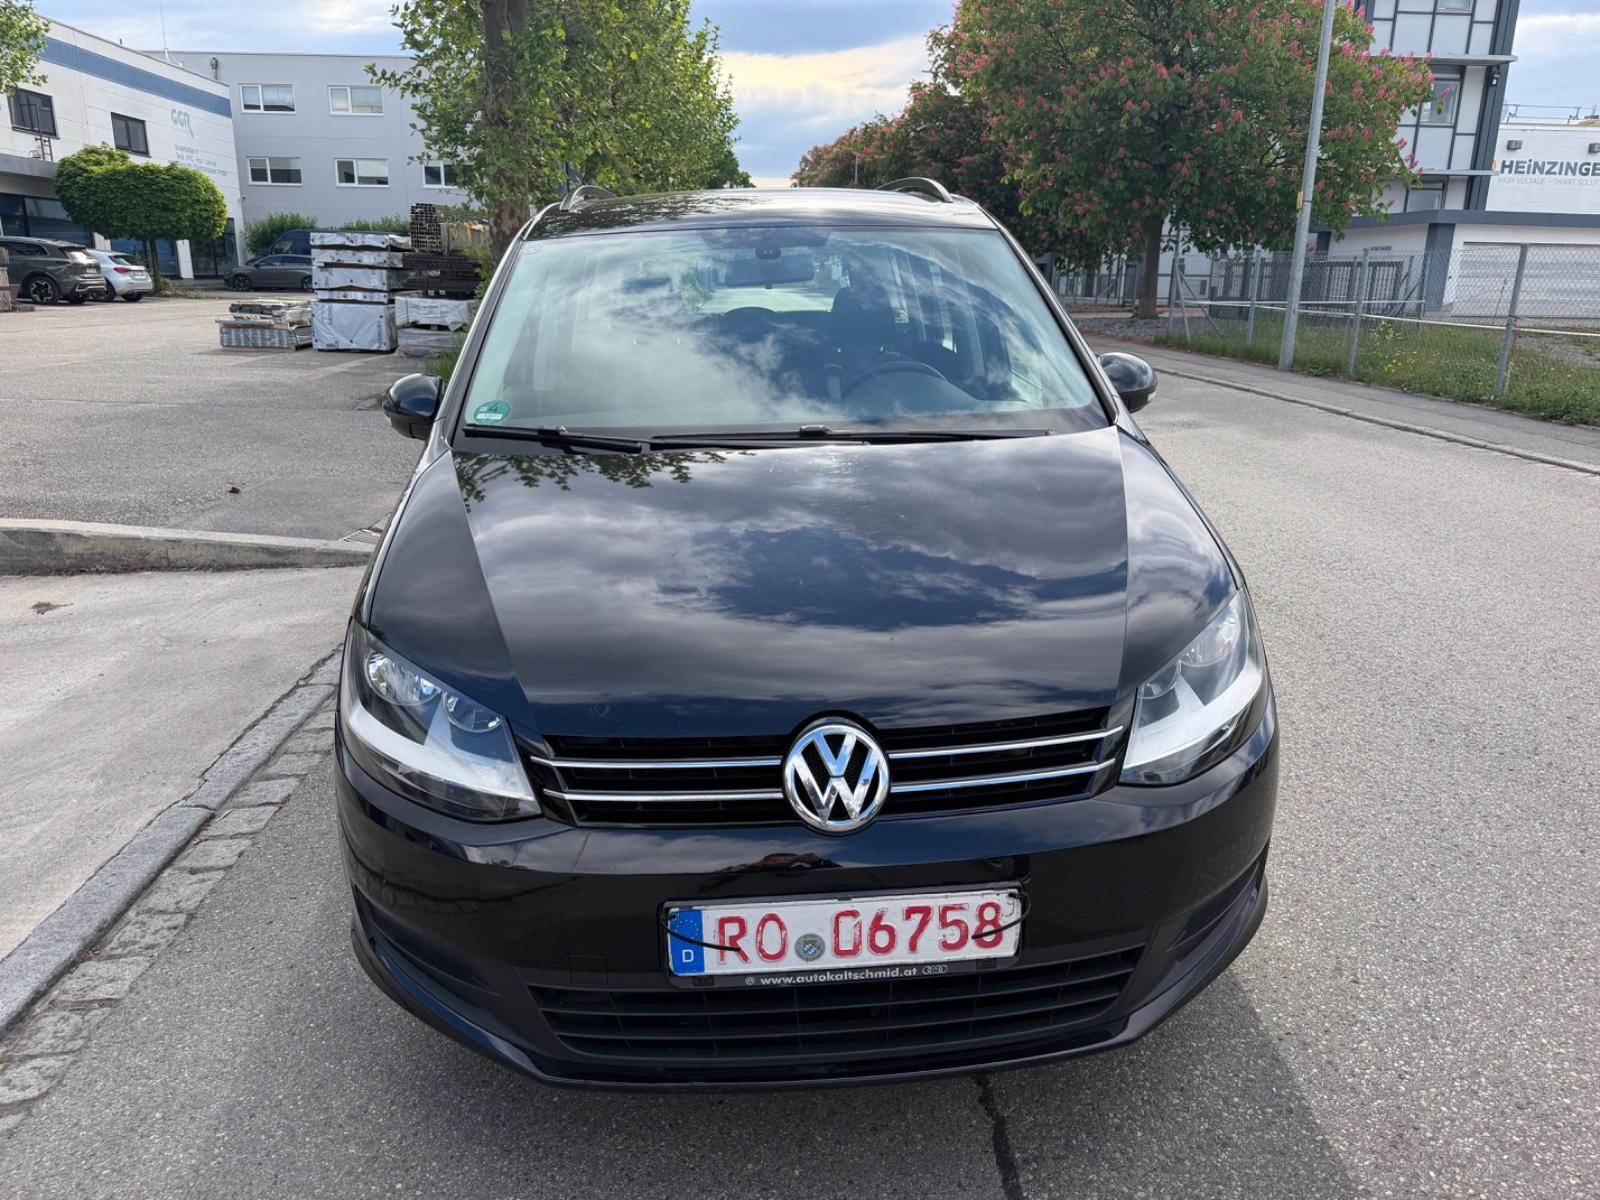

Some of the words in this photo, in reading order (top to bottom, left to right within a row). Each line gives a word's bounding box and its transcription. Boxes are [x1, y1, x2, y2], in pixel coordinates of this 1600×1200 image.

[718, 913, 789, 963] RO
[833, 902, 1003, 958] 06758
[682, 949, 695, 963] D
[760, 967, 917, 986] www.autokaltschmid.at
